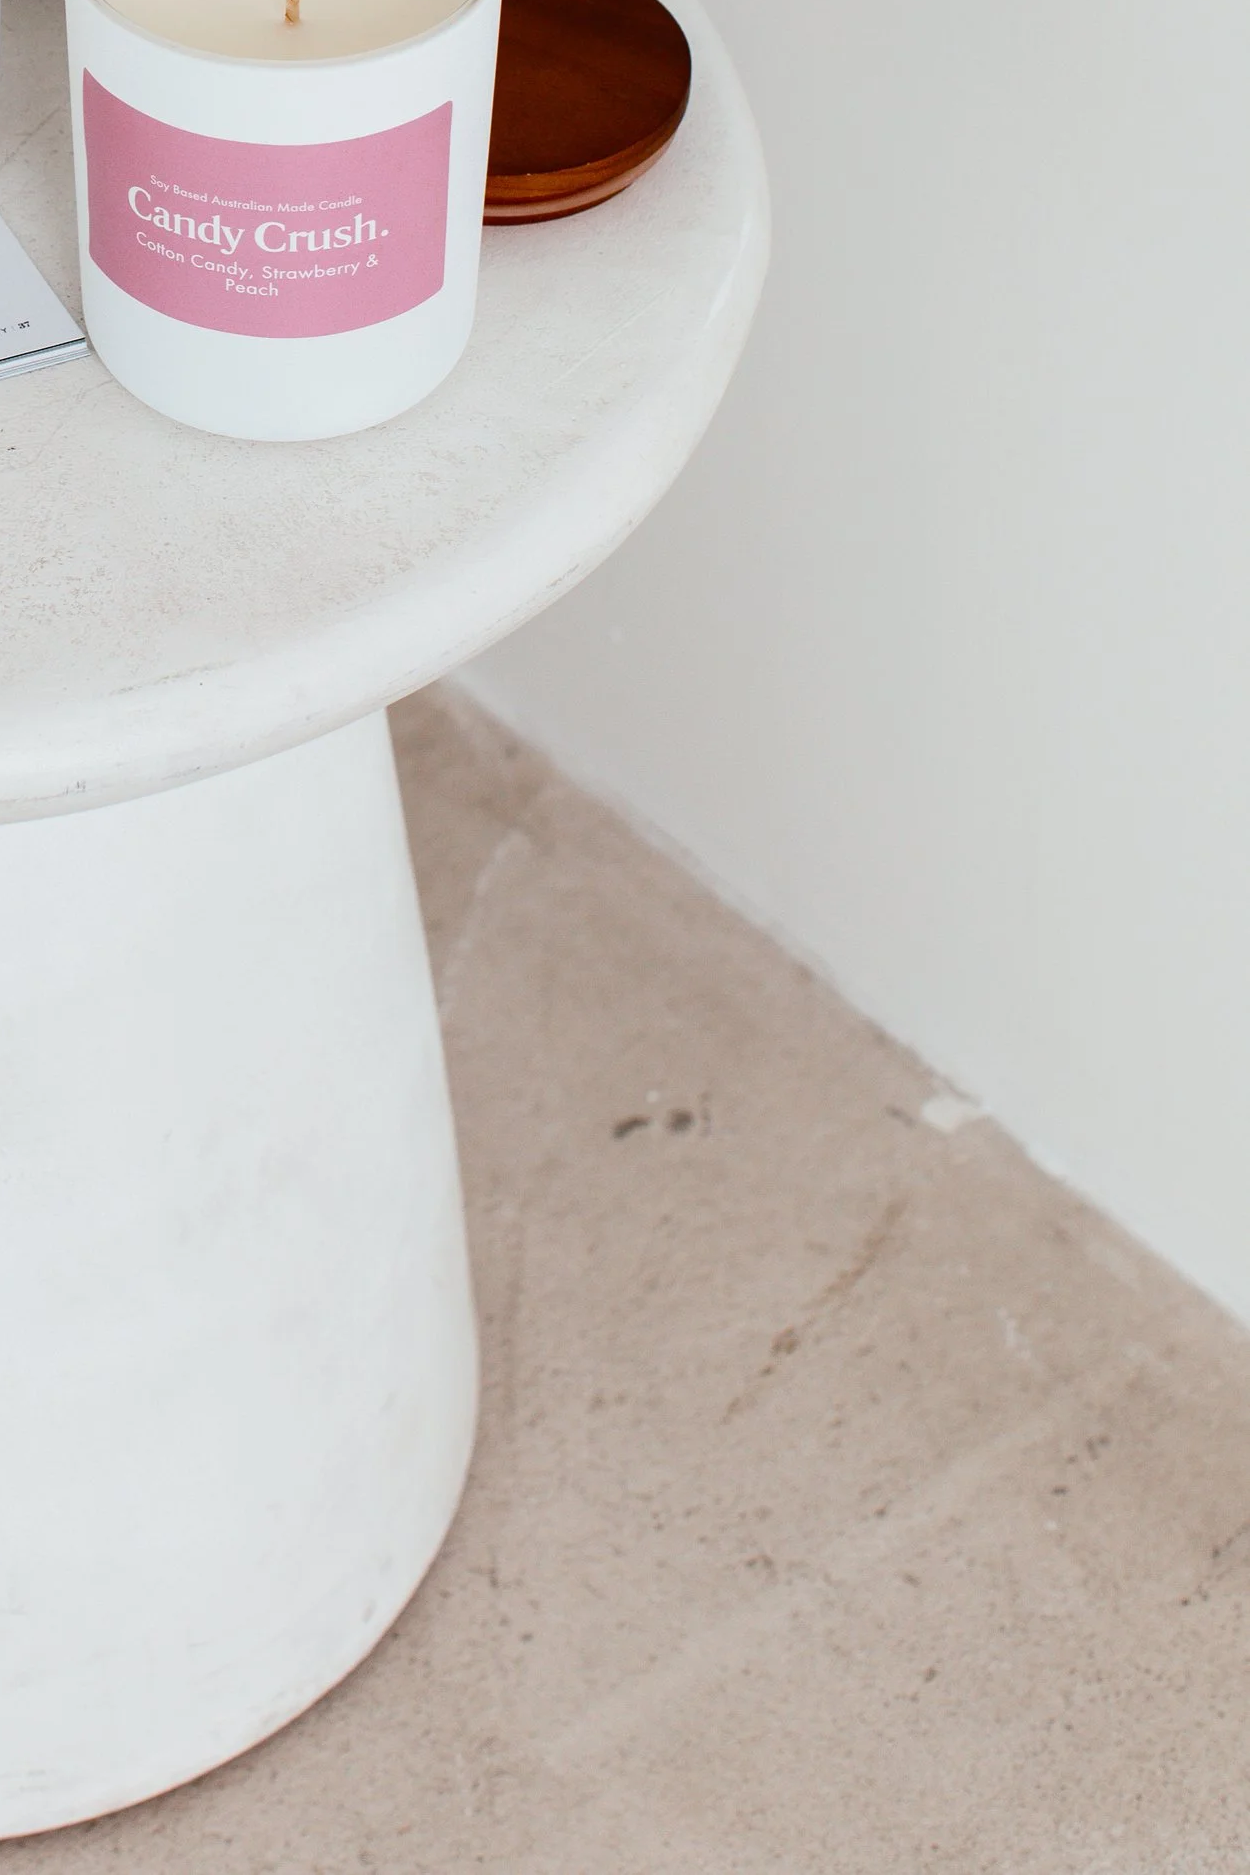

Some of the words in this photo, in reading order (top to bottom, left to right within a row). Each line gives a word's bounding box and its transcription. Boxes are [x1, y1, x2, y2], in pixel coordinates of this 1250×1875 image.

[150, 175, 170, 193] Soy
[173, 184, 208, 203] Based
[211, 195, 273, 212] Australian
[277, 202, 315, 212] Made
[318, 195, 363, 211] Candle
[127, 186, 246, 255] Candy
[254, 213, 389, 253] Crush.
[136, 231, 185, 263] Cotton
[190, 254, 254, 280] Candy,
[262, 260, 361, 280] Strawberry
[366, 254, 379, 268] &
[225, 279, 279, 296] Peach
[17, 320, 31, 330] 37
